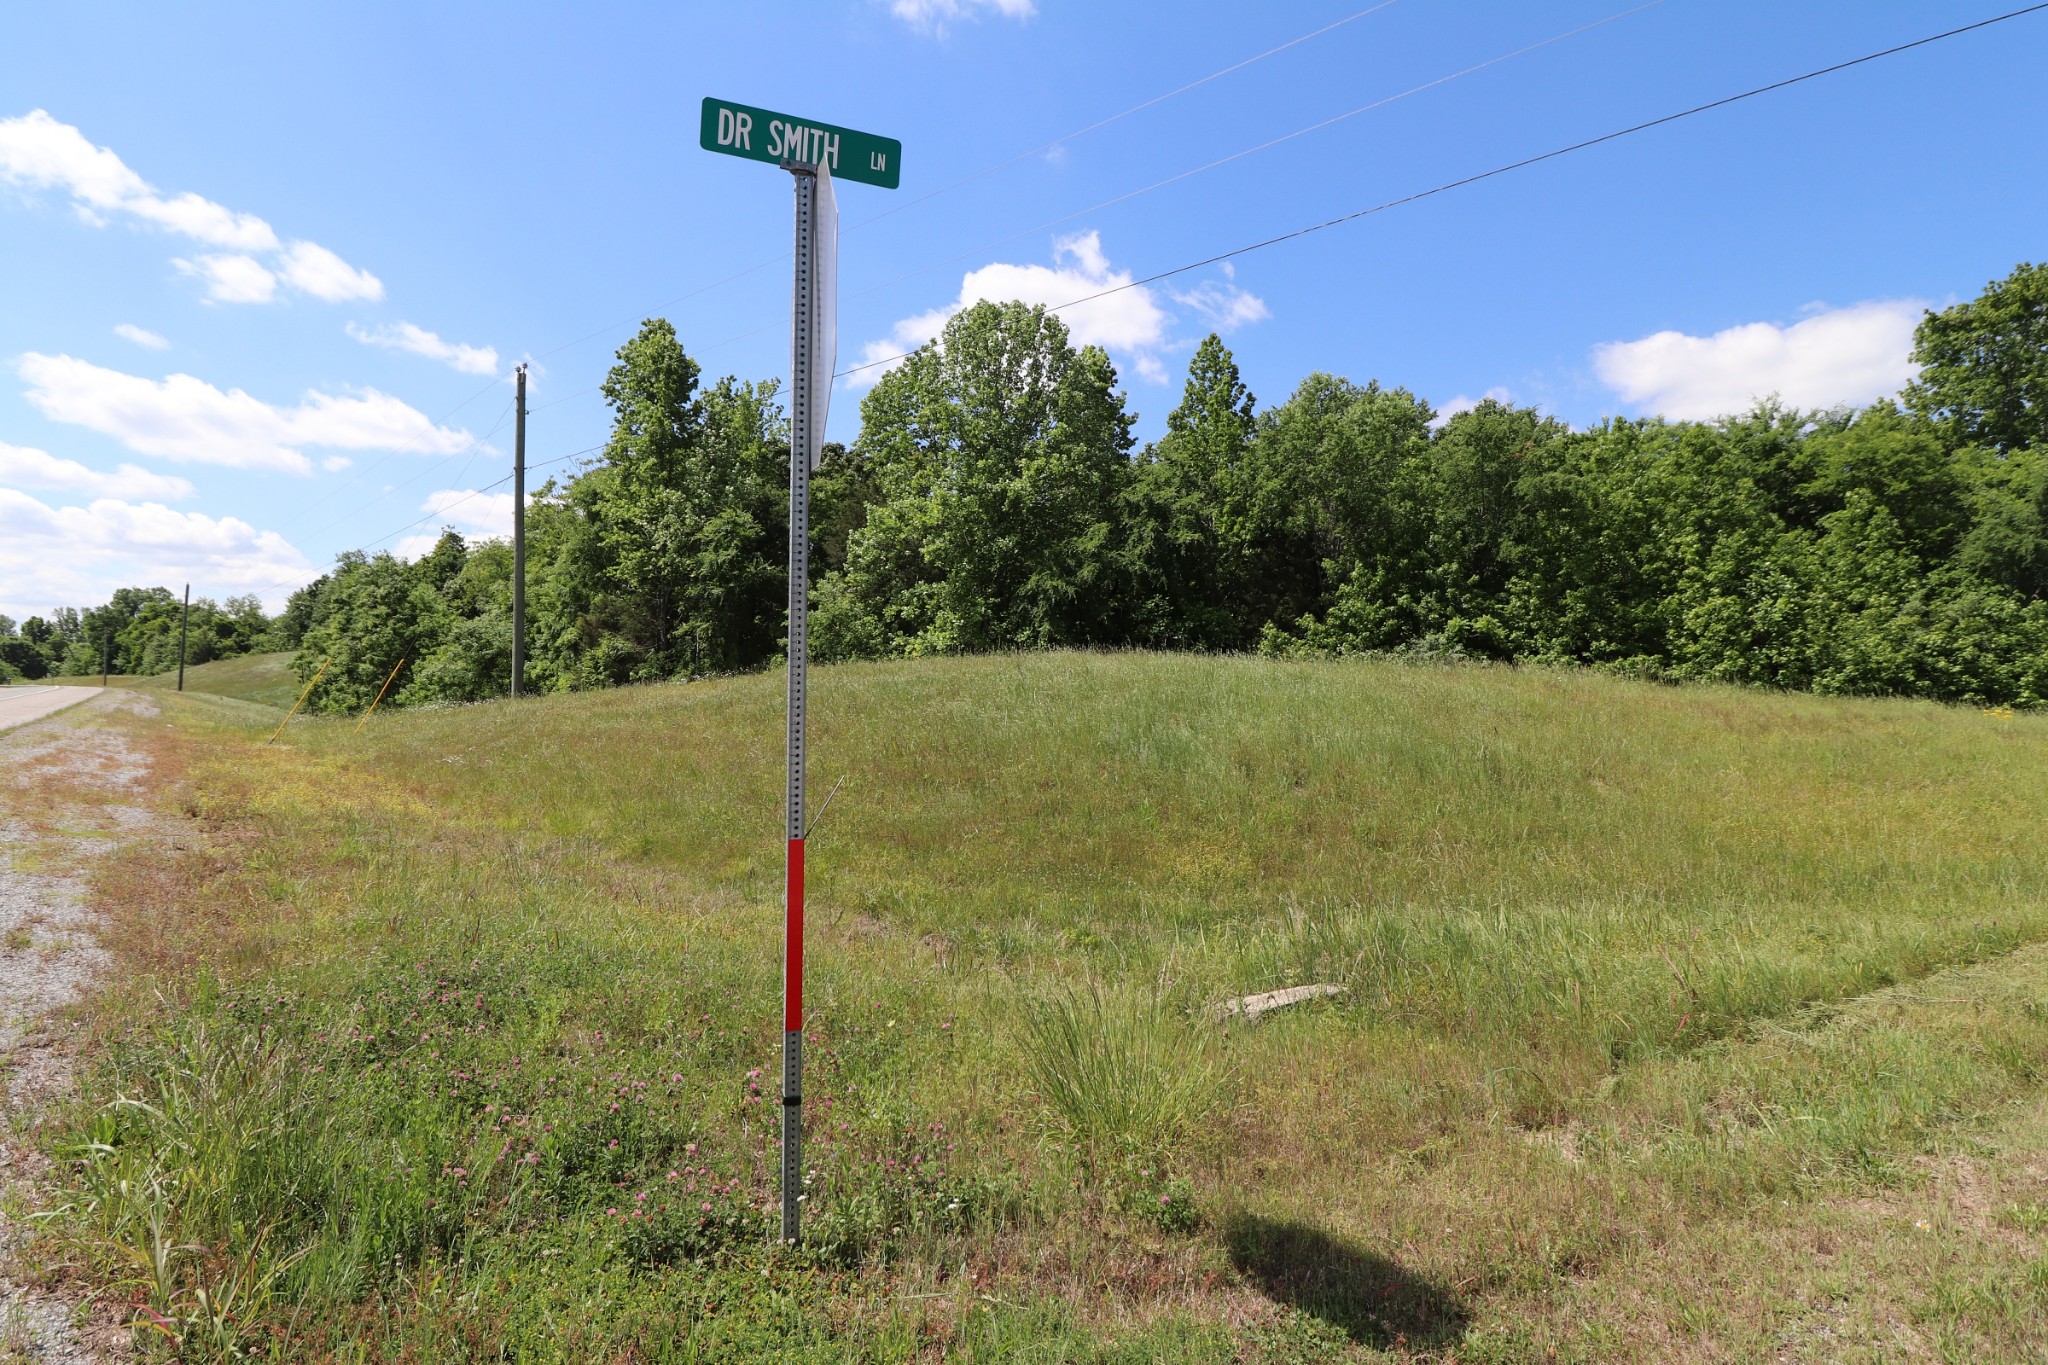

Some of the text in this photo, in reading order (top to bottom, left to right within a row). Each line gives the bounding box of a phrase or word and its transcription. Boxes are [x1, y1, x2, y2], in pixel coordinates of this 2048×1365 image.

[717, 108, 886, 172] DR SMITH LN
